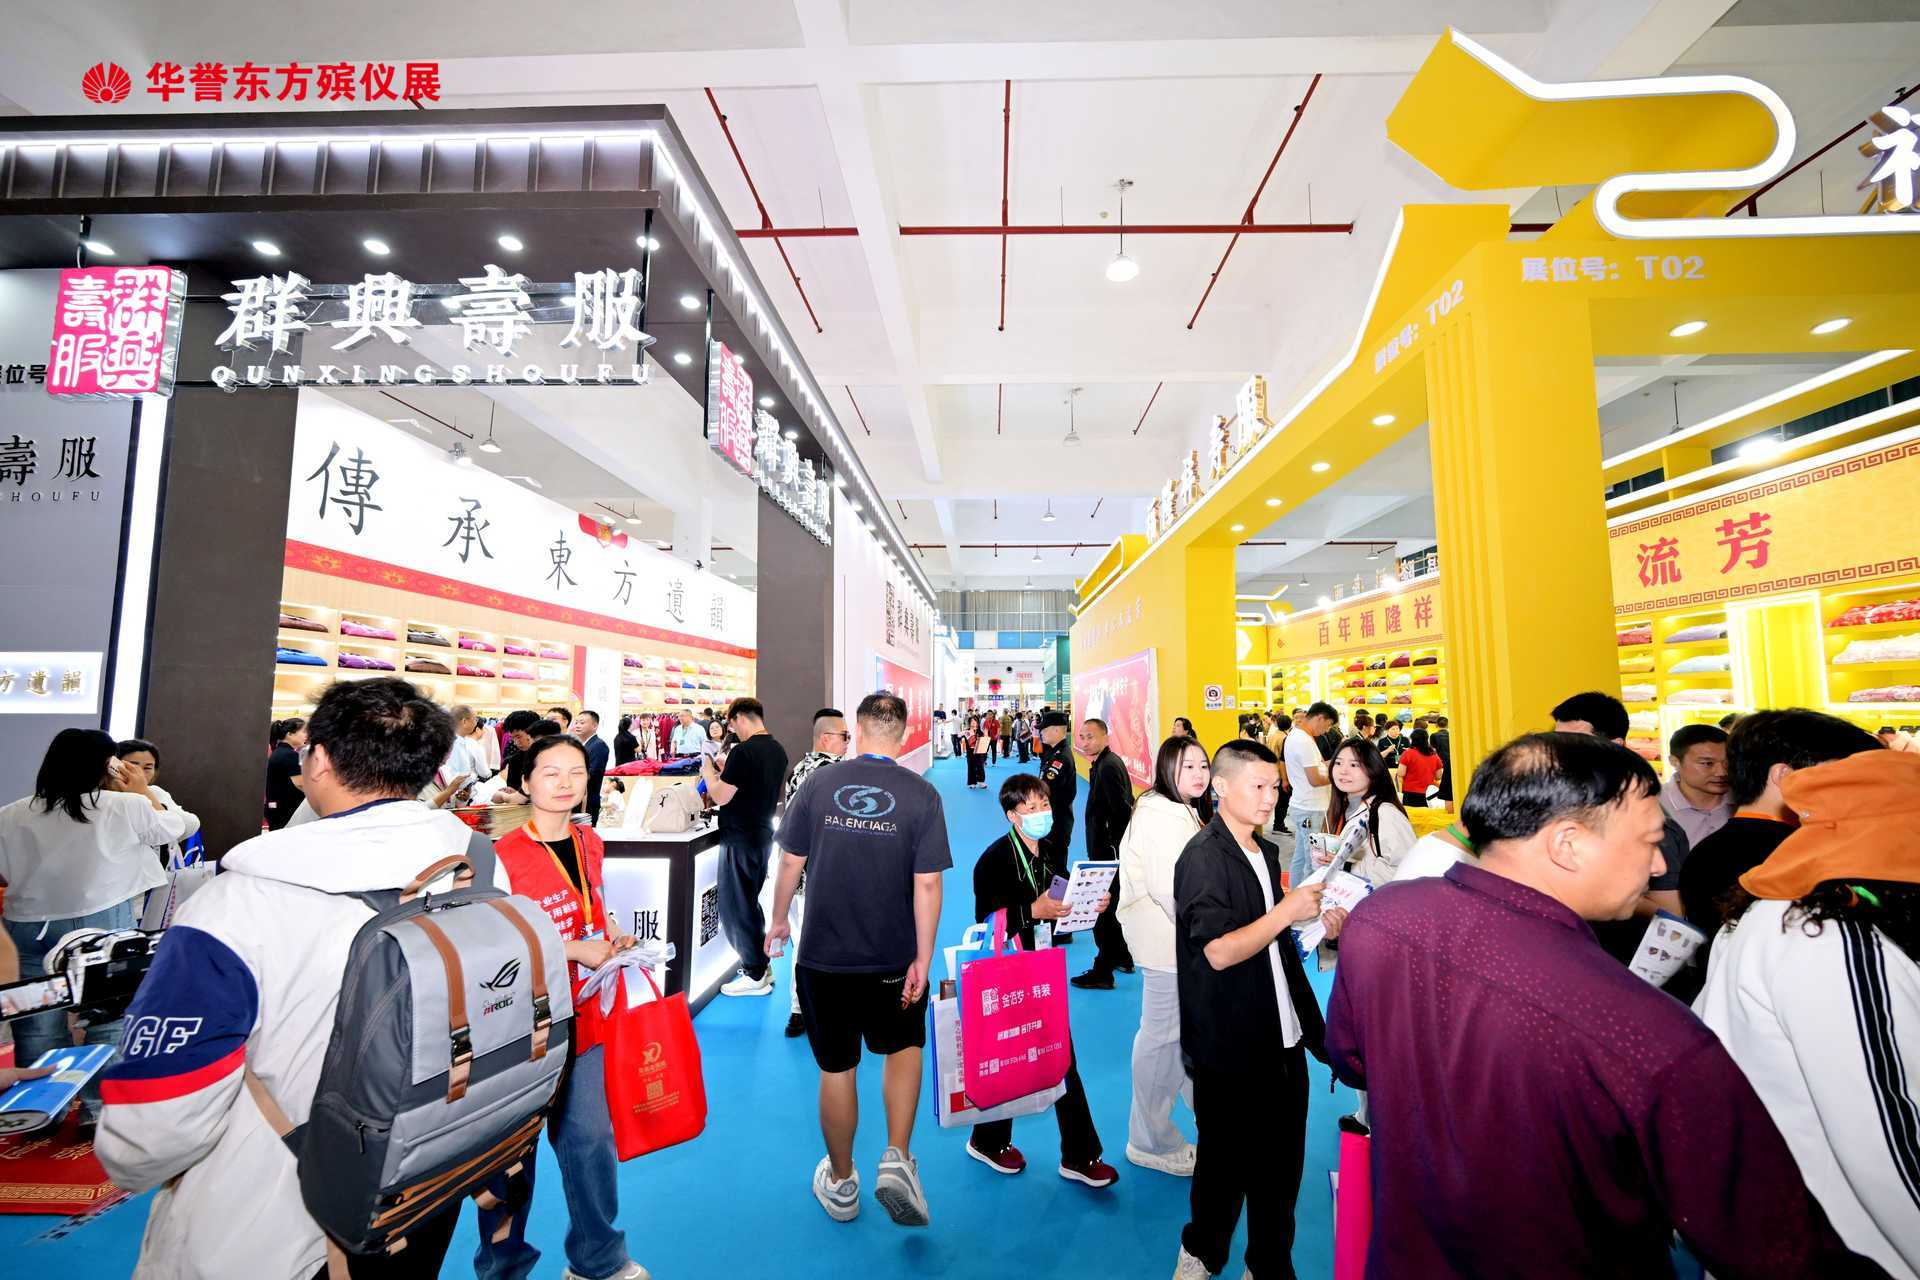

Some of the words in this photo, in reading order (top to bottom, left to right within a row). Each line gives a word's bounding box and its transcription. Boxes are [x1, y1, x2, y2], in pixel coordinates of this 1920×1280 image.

[1635, 255, 1706, 281] T02
[215, 263, 654, 357] 群興壽服
[1424, 279, 1464, 326] T02
[0, 365, 47, 384] 位号
[210, 363, 650, 388] QUNXINGSHOUFU
[0, 491, 101, 503] HOUFU
[1636, 511, 1772, 589] 流芳
[1317, 594, 1433, 647] 百年福隆祥
[824, 815, 898, 833] BALENCIAGA
[535, 888, 569, 906] 业生产
